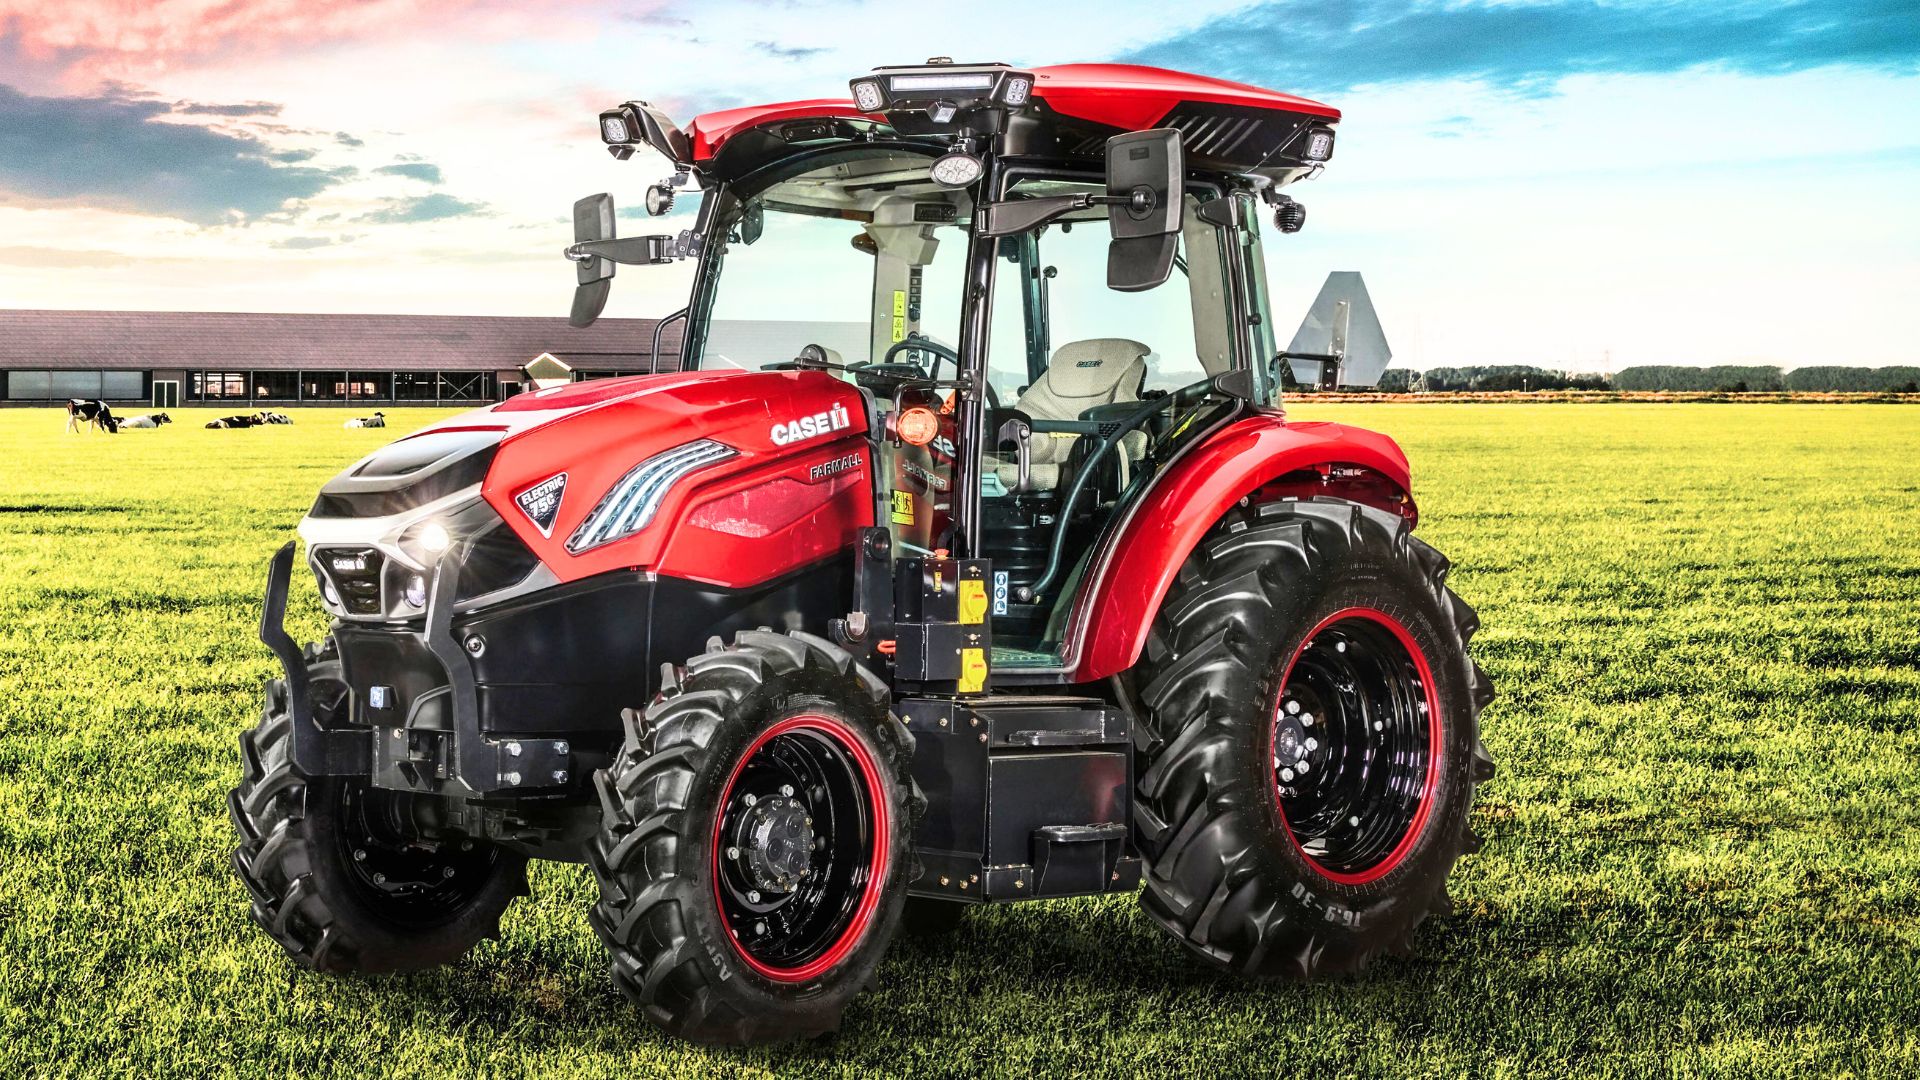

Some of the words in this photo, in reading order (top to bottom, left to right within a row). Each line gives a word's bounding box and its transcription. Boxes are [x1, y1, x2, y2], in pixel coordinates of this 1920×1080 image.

[771, 412, 830, 446] CASE
[810, 453, 862, 480] FARMALL
[521, 476, 564, 505] ELECTRIC
[529, 493, 555, 517] 75C
